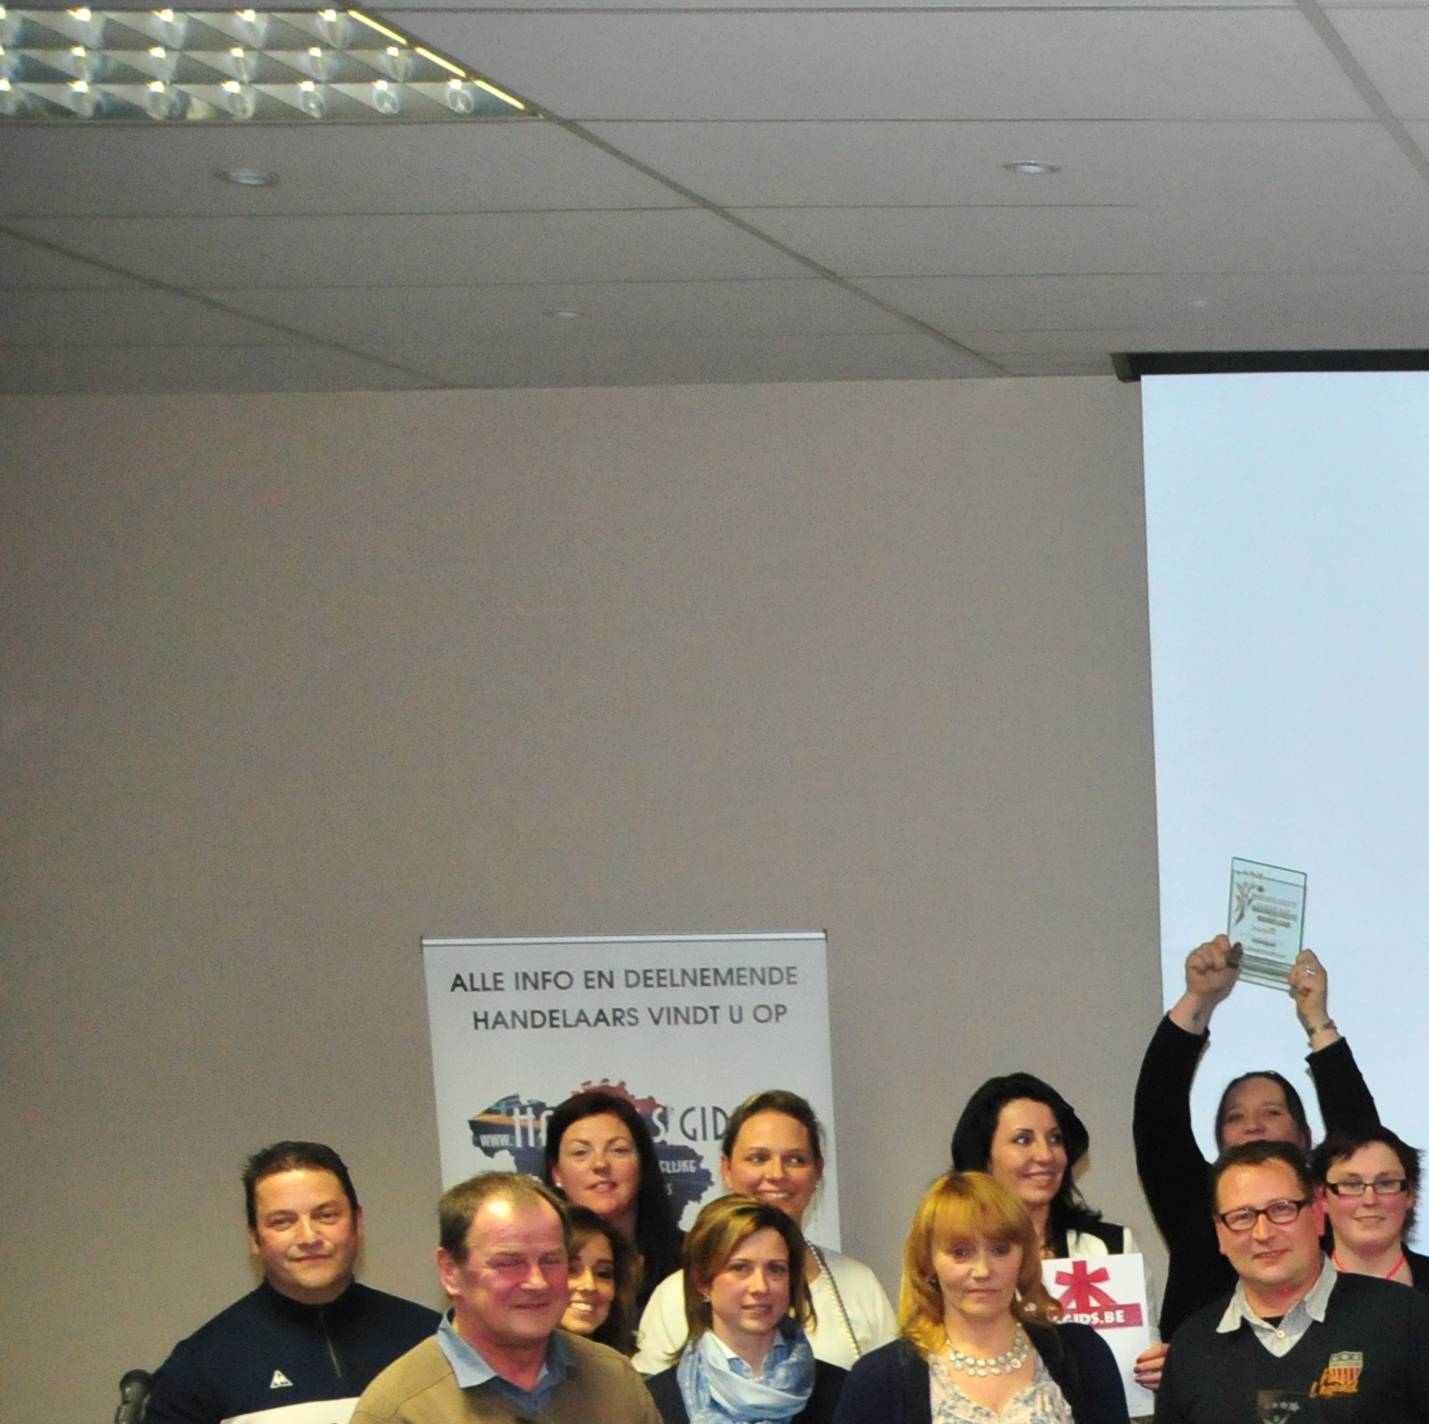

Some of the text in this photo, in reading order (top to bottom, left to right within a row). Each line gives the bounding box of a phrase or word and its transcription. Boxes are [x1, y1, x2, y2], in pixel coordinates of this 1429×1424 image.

[451, 966, 798, 992] ALLE INFO EN DEELNEMENDE
[473, 1004, 788, 1030] HANDELAARS VINDT U OP
